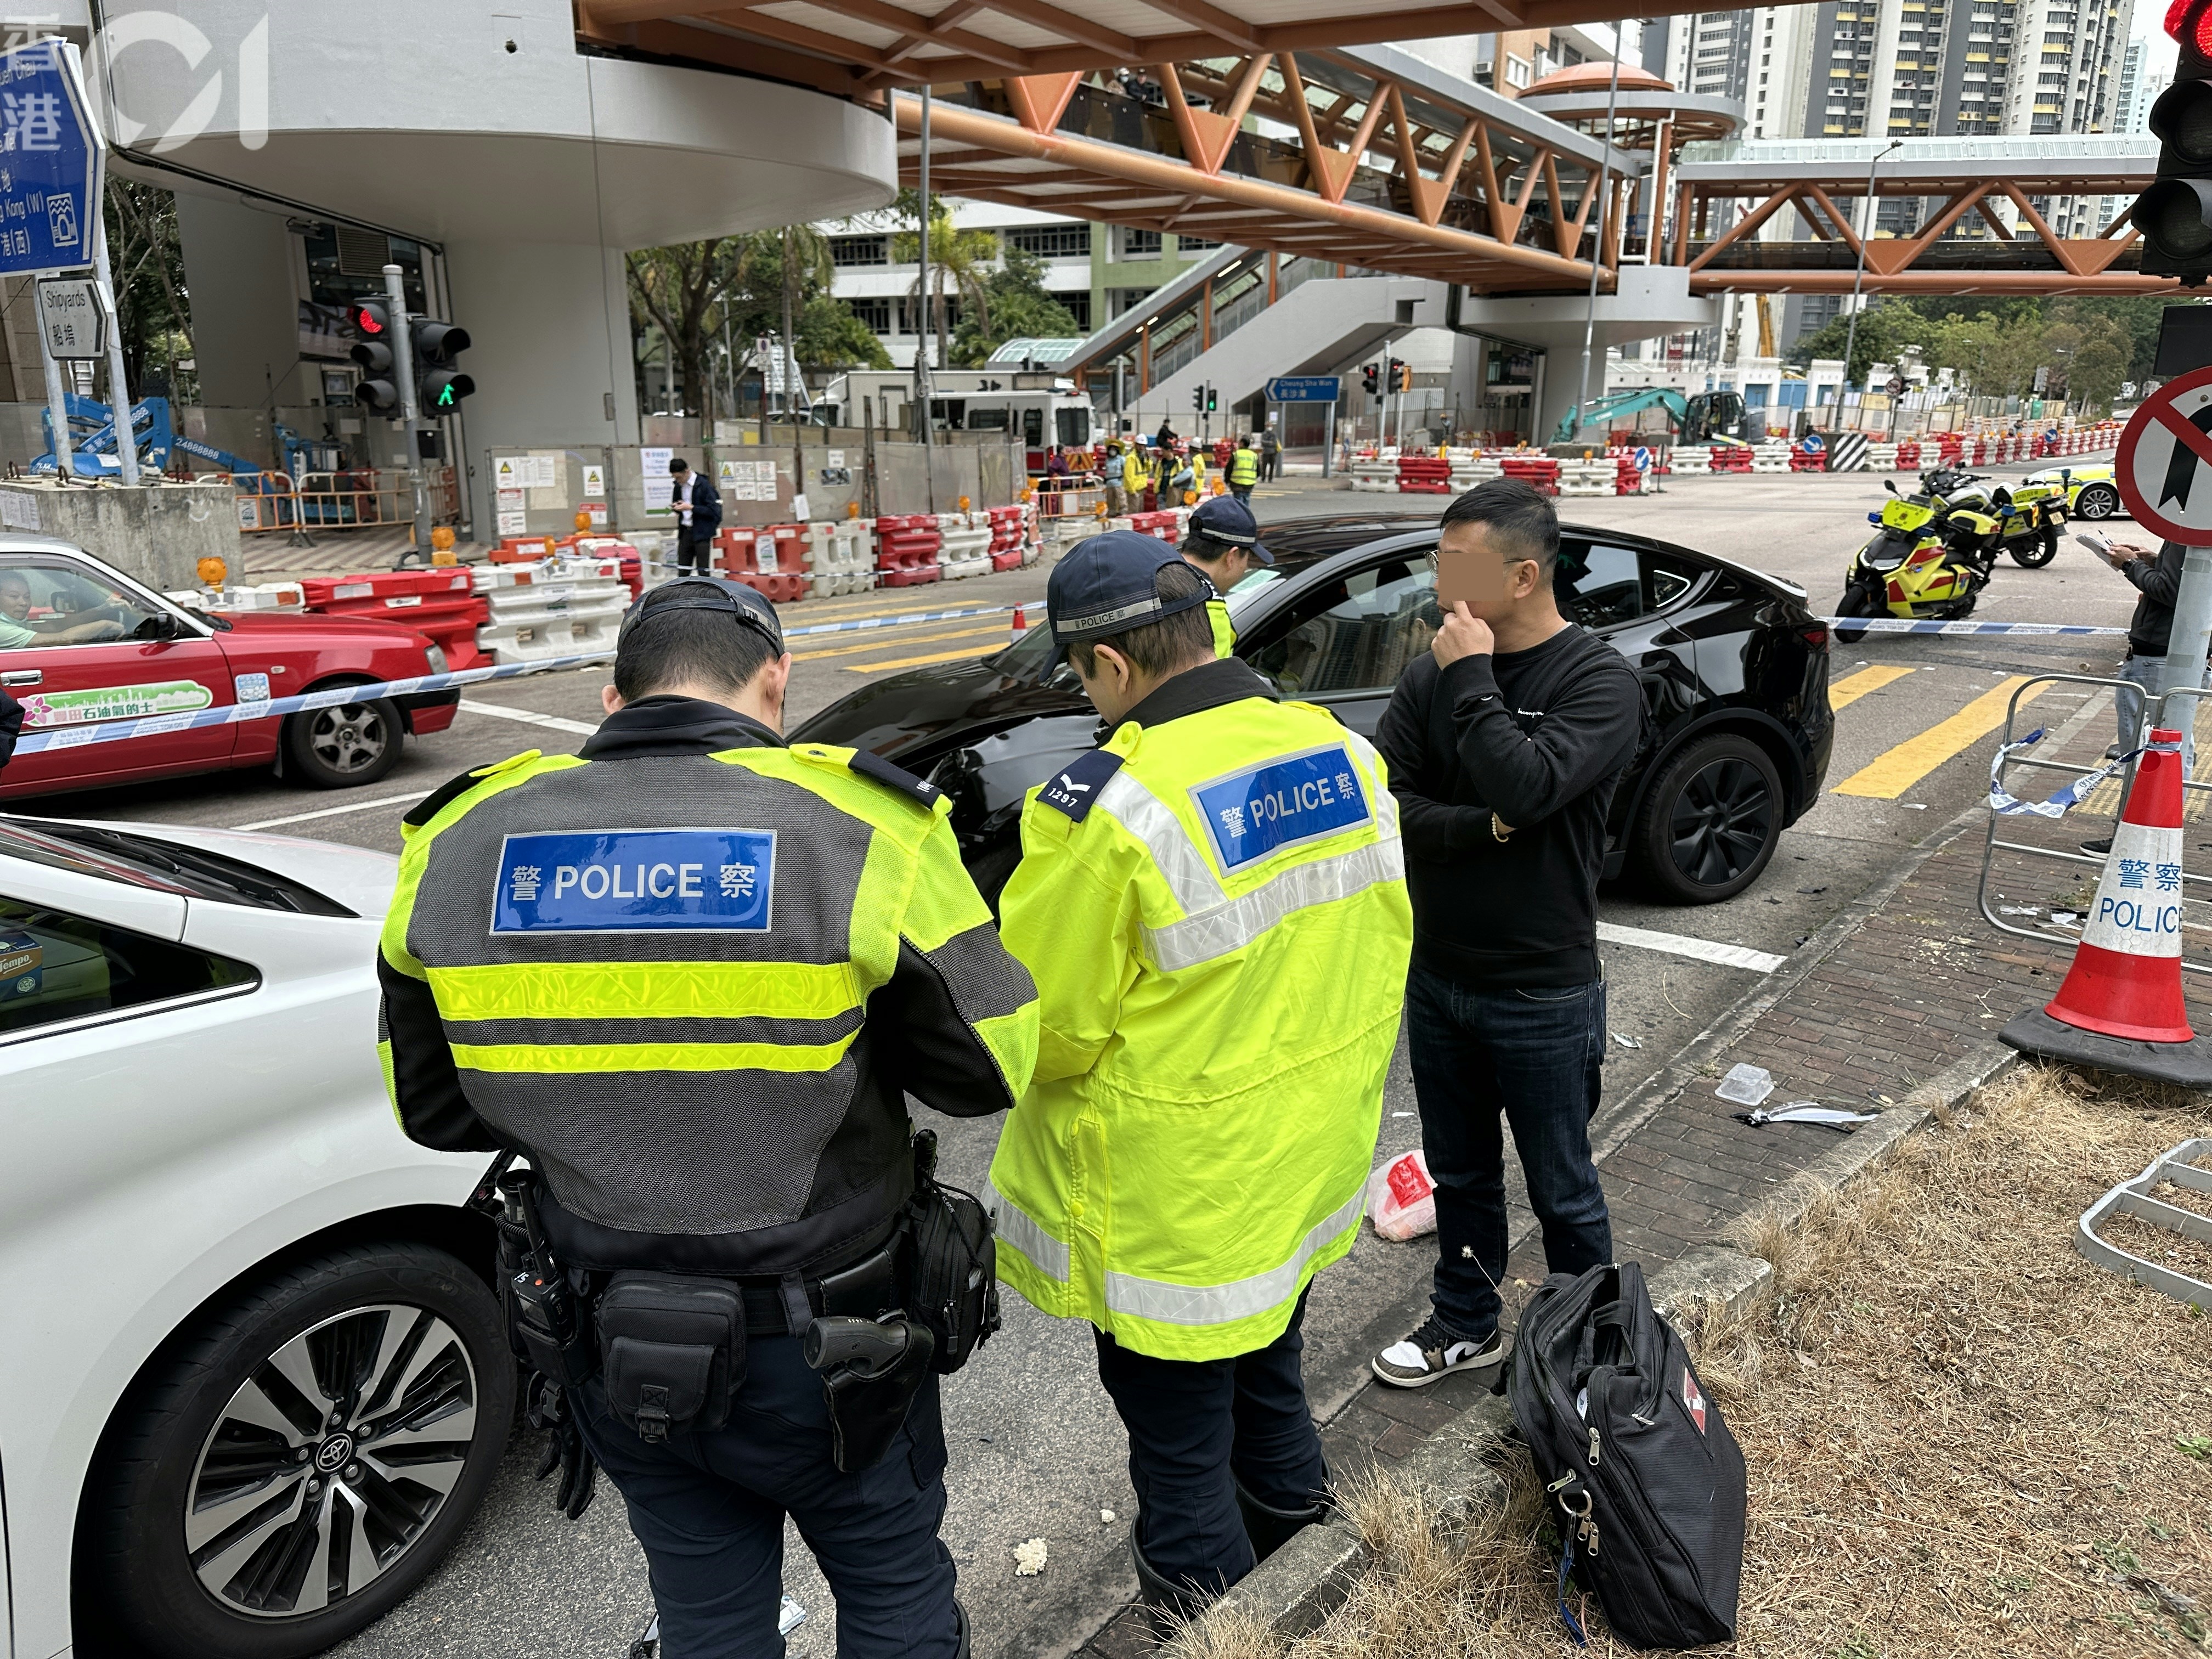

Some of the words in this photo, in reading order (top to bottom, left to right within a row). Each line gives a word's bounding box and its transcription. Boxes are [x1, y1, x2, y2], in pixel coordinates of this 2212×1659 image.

[4, 198, 26, 220] Kong
[26, 190, 44, 214] (W)
[46, 290, 86, 312] Shipyards
[1280, 380, 1305, 388] Cheung
[1280, 389, 1307, 398] 長沙灣
[1081, 612, 1115, 628] POLICE
[1116, 609, 1125, 619] 察
[1048, 788, 1078, 808] 1297
[1220, 806, 1247, 838] 警
[1249, 778, 1335, 828] POLICE
[1334, 772, 1356, 800] 察
[510, 865, 541, 901] 警
[554, 863, 703, 900] POLICE
[719, 862, 755, 899] 察
[2118, 859, 2181, 891] 警察
